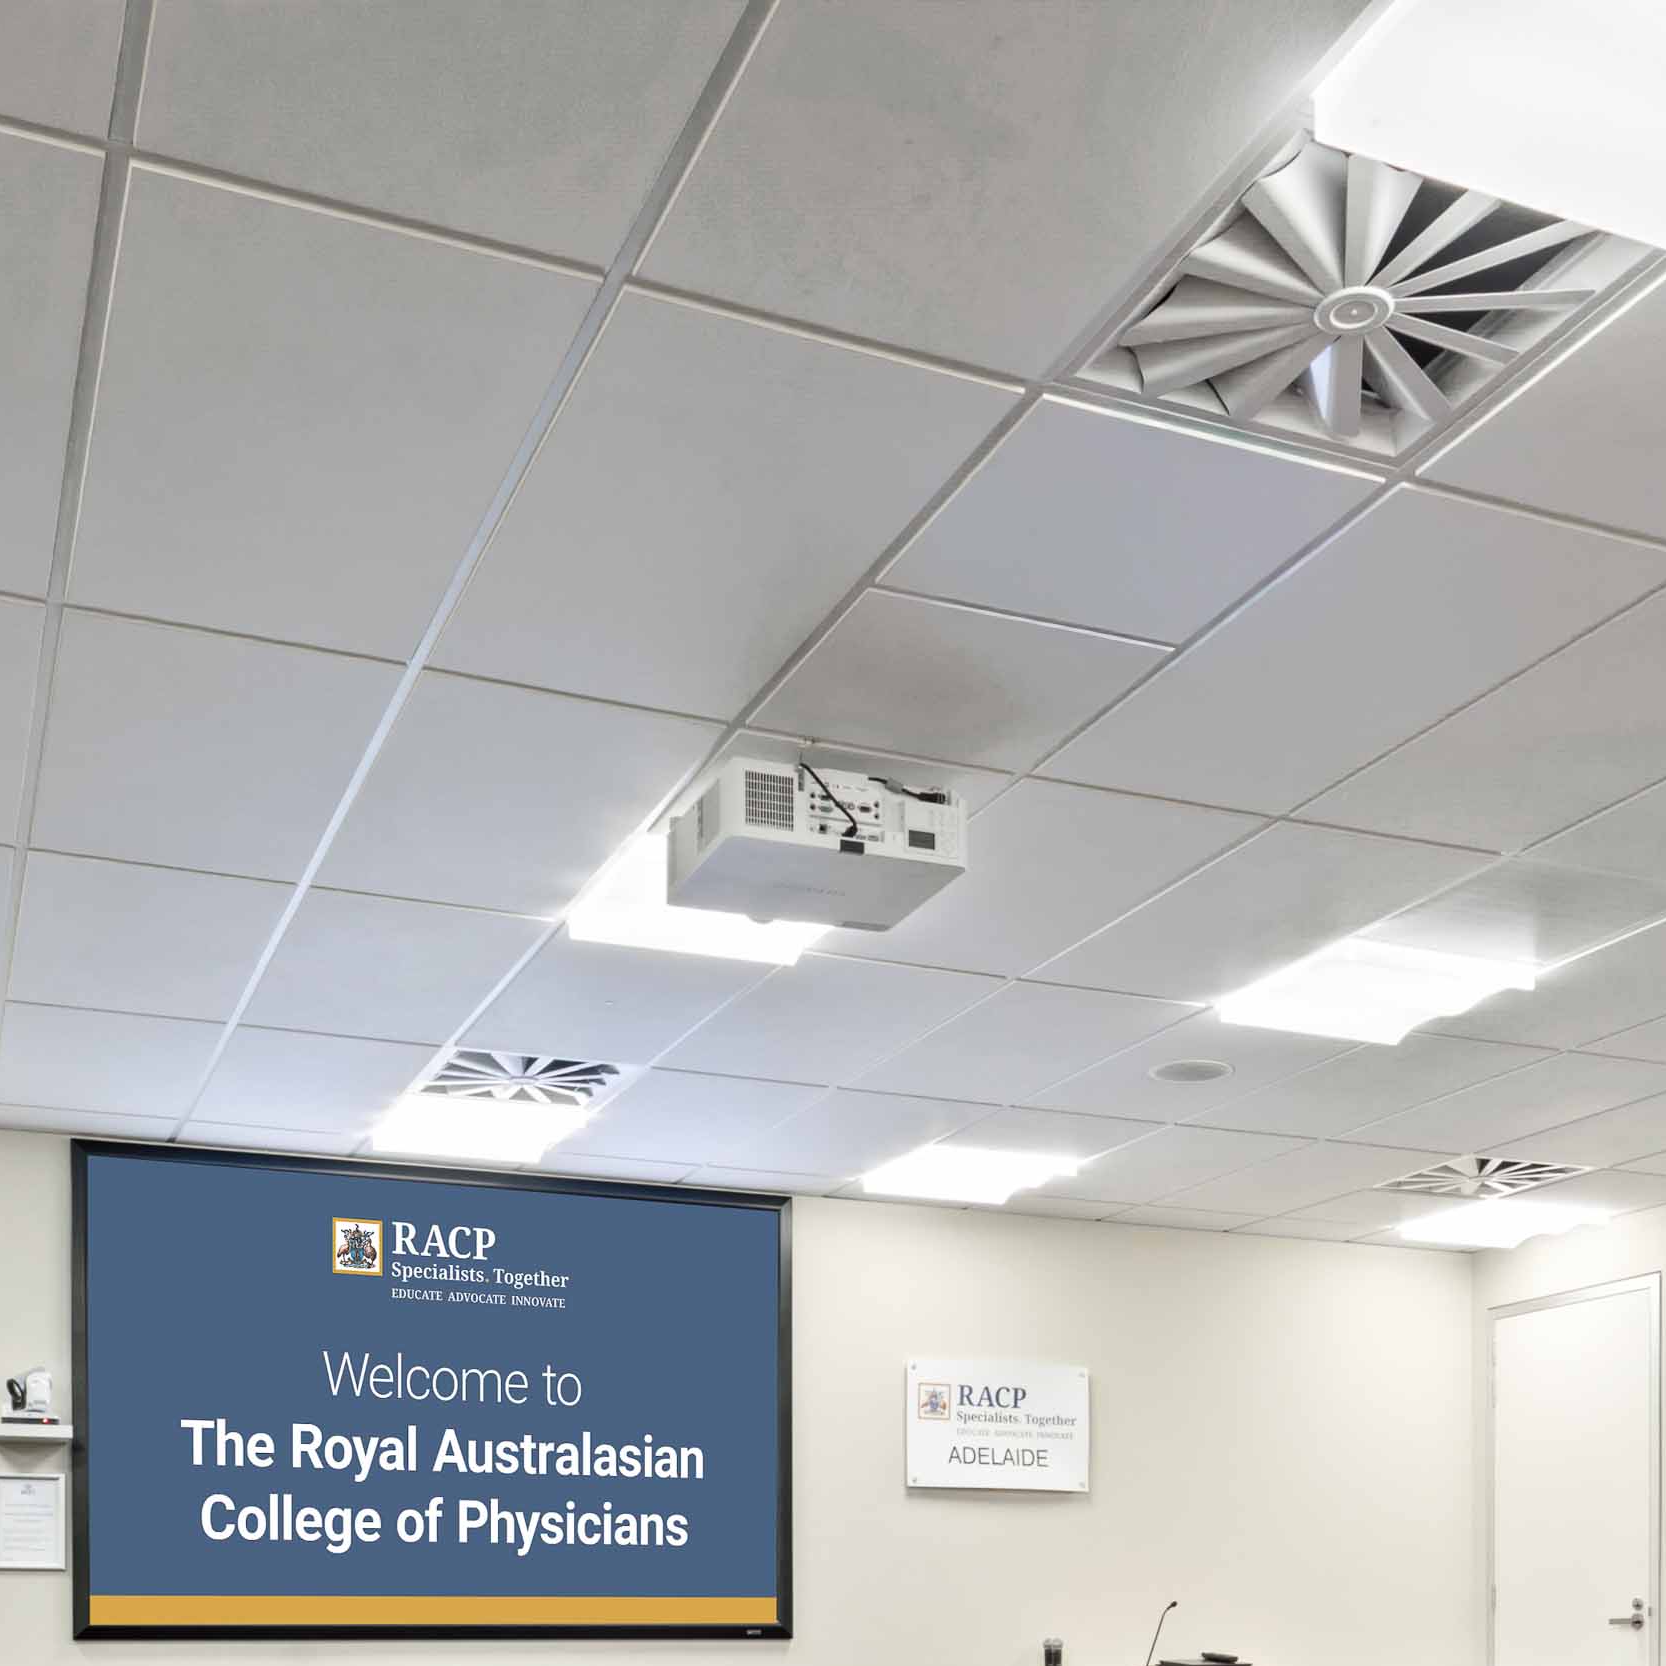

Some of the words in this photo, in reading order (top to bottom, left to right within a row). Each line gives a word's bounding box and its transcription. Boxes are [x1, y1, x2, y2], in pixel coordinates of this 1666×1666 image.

[391, 1221, 497, 1261] RACP
[492, 1267, 570, 1290] Together
[391, 1287, 444, 1301] EDUCATE
[447, 1291, 507, 1305] ADVOCATE
[511, 1295, 566, 1309] INNOVATE
[322, 1350, 529, 1406] Welcome
[541, 1364, 583, 1407] to
[957, 1384, 1027, 1409] RACP
[1024, 1413, 1078, 1428] Together
[180, 1418, 275, 1469] The
[292, 1423, 417, 1484] Royal
[431, 1428, 705, 1480] Australasian
[948, 1445, 1049, 1468] ADELAIDE
[200, 1493, 383, 1555] College
[395, 1496, 445, 1544] of
[457, 1498, 690, 1558] Physicians
